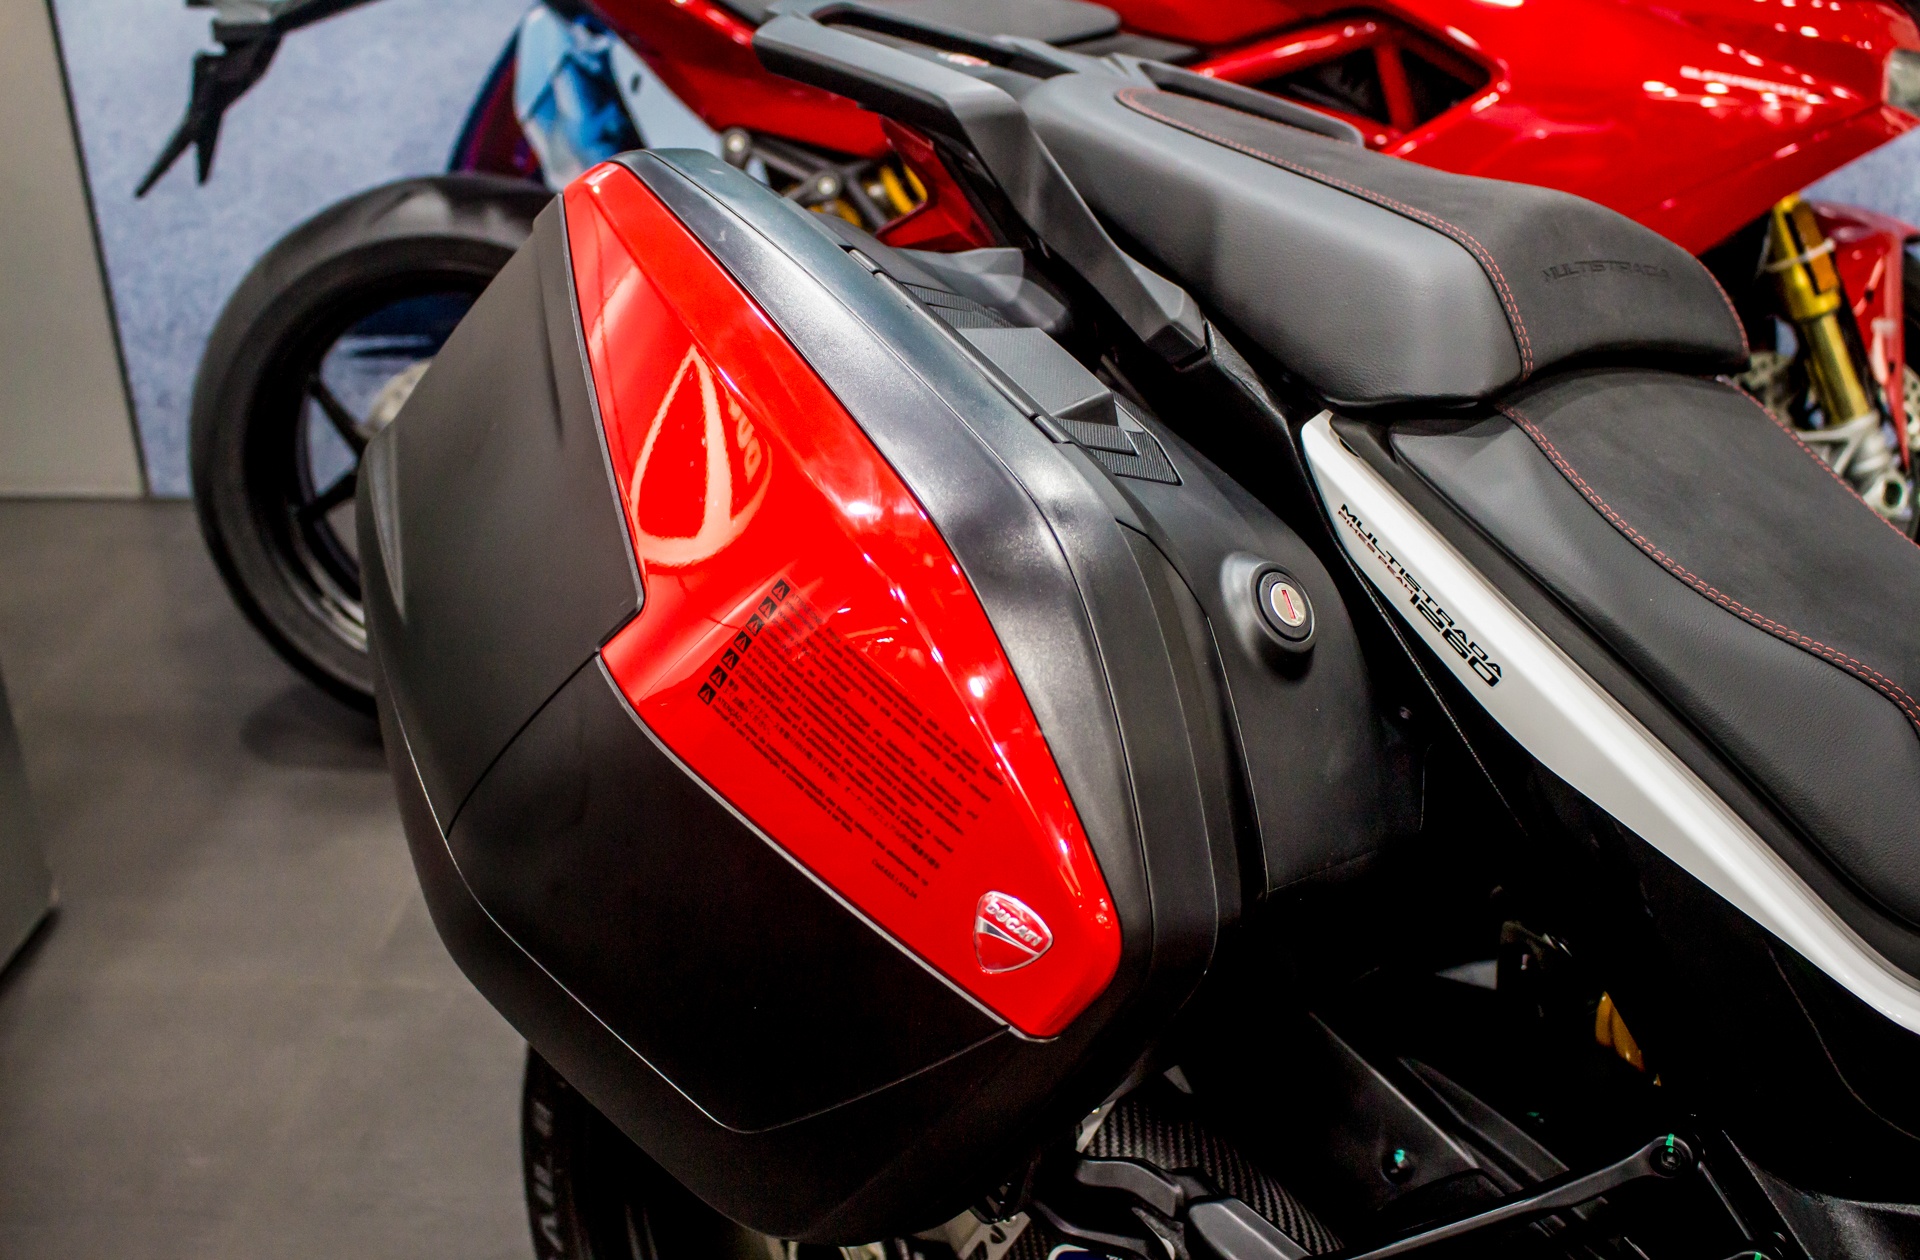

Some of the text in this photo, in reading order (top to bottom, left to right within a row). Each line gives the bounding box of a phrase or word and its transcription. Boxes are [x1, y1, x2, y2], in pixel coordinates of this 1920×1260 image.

[1340, 503, 1502, 679] MULTISTRADA
[1410, 593, 1500, 687] 1260
[985, 900, 1043, 947] DUCATI
